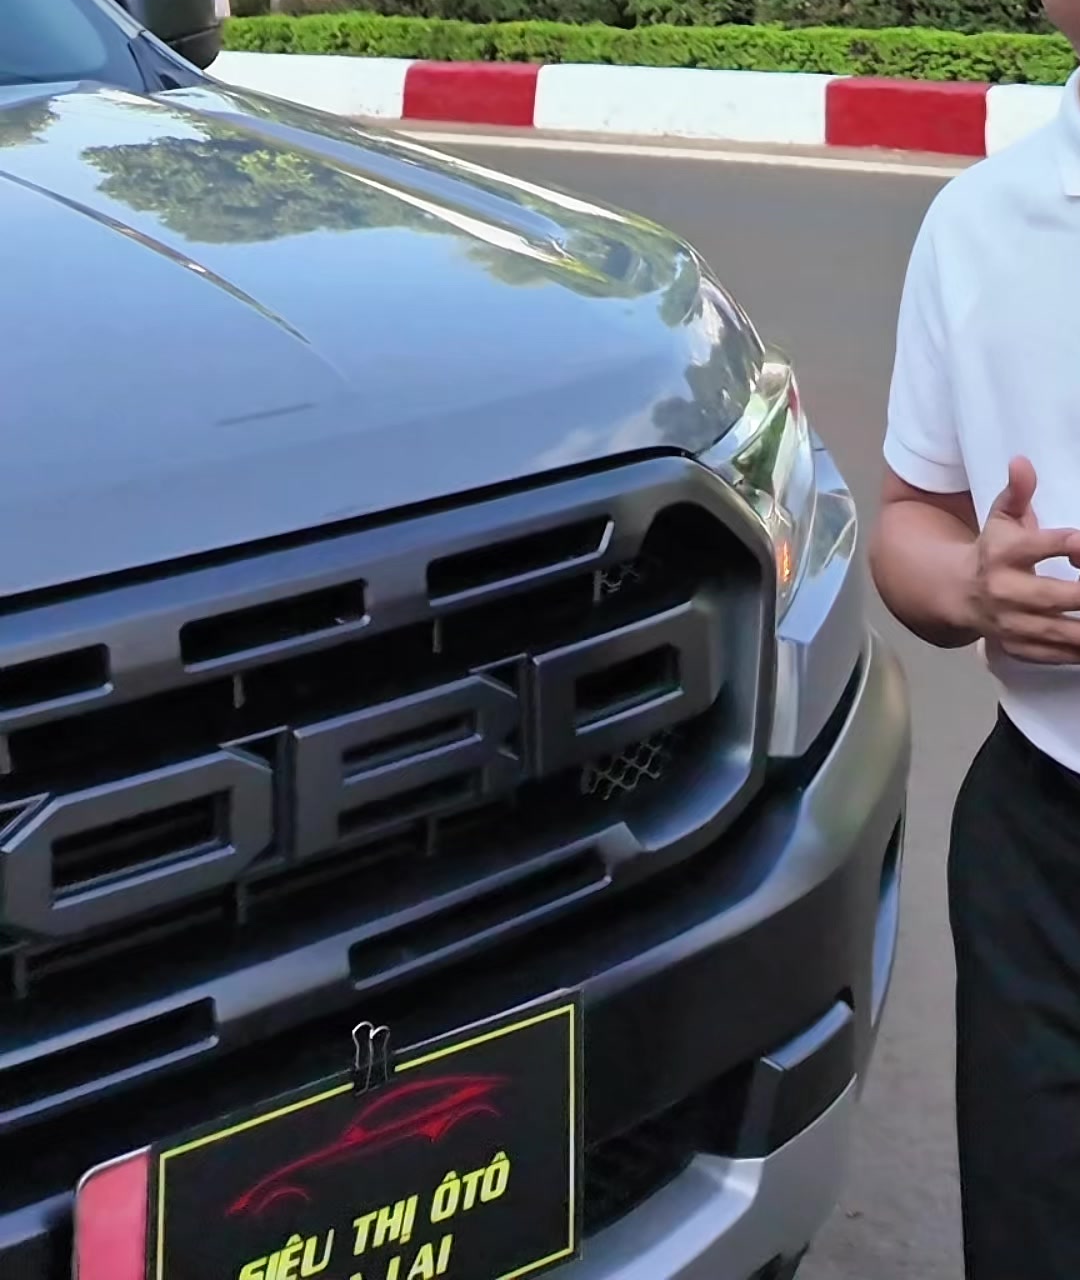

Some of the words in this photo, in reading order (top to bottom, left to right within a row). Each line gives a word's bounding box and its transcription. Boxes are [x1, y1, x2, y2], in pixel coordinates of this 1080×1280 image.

[0, 595, 722, 942] ORD
[353, 1195, 418, 1256] THỊ
[430, 1151, 510, 1224] ÔTÔ
